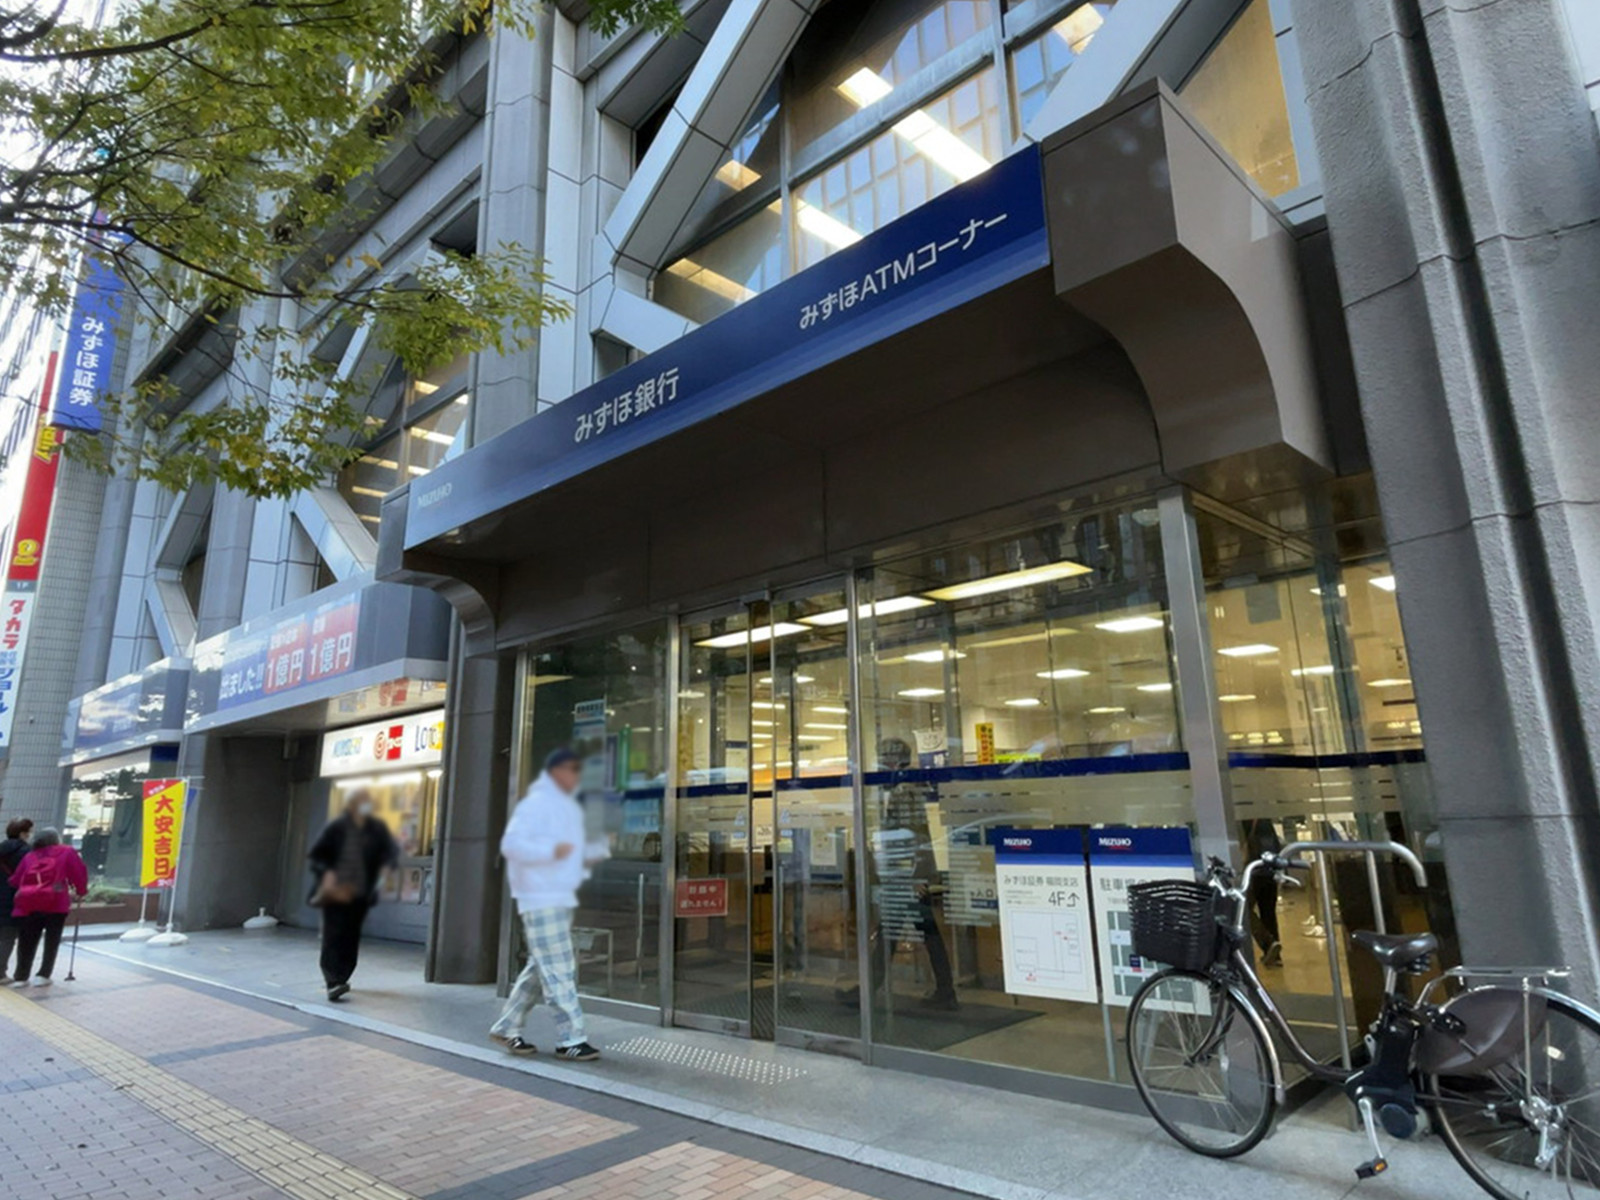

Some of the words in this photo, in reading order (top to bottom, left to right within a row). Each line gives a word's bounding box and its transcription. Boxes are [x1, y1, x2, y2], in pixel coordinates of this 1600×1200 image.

[799, 213, 1008, 330] みずほATMコーナー
[69, 316, 105, 407] みずほ証券
[574, 367, 680, 443] みずほ銀行
[2, 599, 26, 650] タカラ
[267, 647, 305, 689] 1億円
[311, 631, 354, 676] 1億円
[154, 795, 175, 877] 大安吉日
[1003, 837, 1032, 846] MIZUHO
[1098, 837, 1132, 847] MIZUHO
[1048, 890, 1066, 906] 4F
